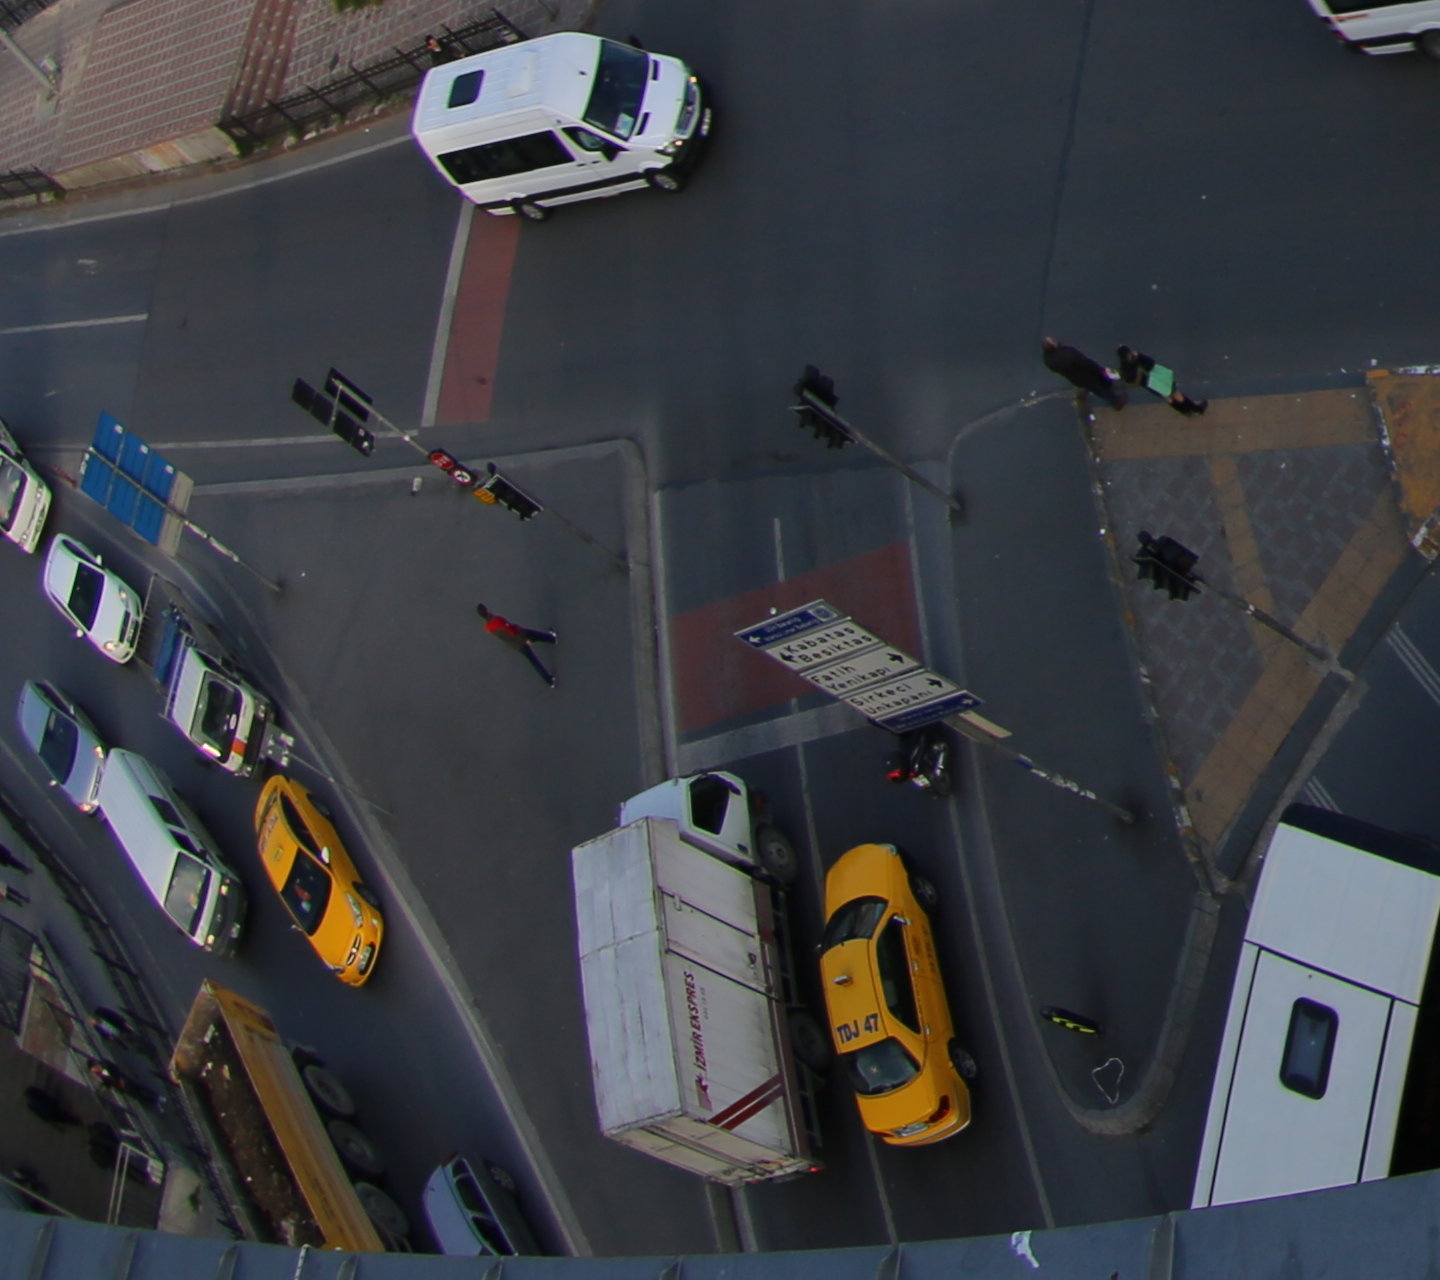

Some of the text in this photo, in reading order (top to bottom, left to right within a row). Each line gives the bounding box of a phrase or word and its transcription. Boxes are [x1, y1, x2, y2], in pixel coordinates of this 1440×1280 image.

[811, 664, 857, 685] Fatih
[850, 683, 914, 707] Sirkeci
[682, 971, 703, 1033] EKSPRES
[836, 1012, 880, 1044] TDJ 47
[692, 1032, 709, 1073] İZMİR
